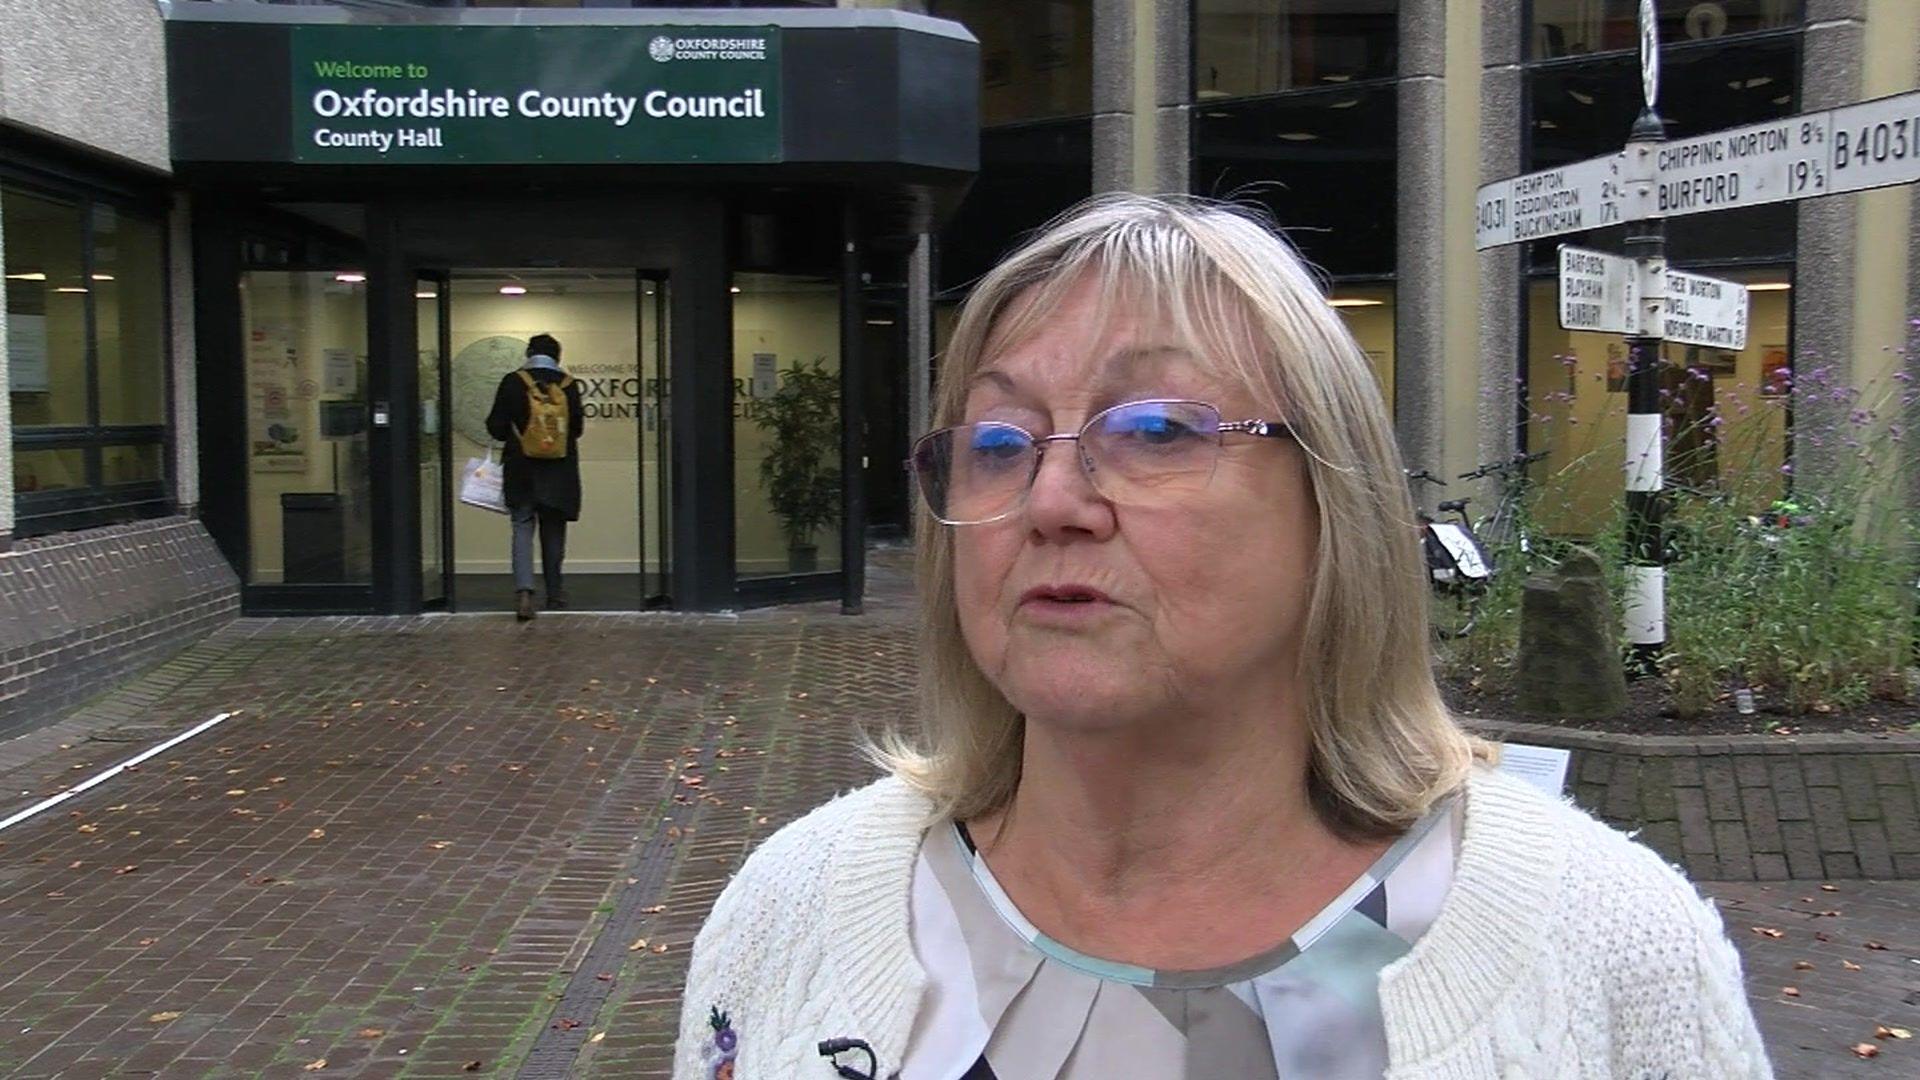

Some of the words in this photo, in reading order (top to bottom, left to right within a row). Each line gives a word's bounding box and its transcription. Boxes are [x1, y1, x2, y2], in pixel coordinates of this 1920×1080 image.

[675, 39, 766, 50] OXFORDSHIRE
[675, 51, 718, 60] COUNTY
[719, 51, 766, 60] COUNCIL
[314, 61, 403, 79] Welcome
[407, 63, 428, 79] to
[313, 88, 510, 119] Oxfordshire
[517, 90, 637, 126] County
[643, 88, 765, 119] Council
[314, 129, 394, 152] County
[398, 128, 443, 148] Hall
[1658, 139, 1723, 172] CHIPPING
[1728, 127, 1789, 160] NORTON
[1834, 116, 1920, 170] B4031
[1514, 171, 1564, 196] HEMPTON
[1658, 172, 1740, 212] BURFORD
[1514, 188, 1579, 216] DEDDINGTON
[1514, 208, 1583, 239] BUCKINGHAM
